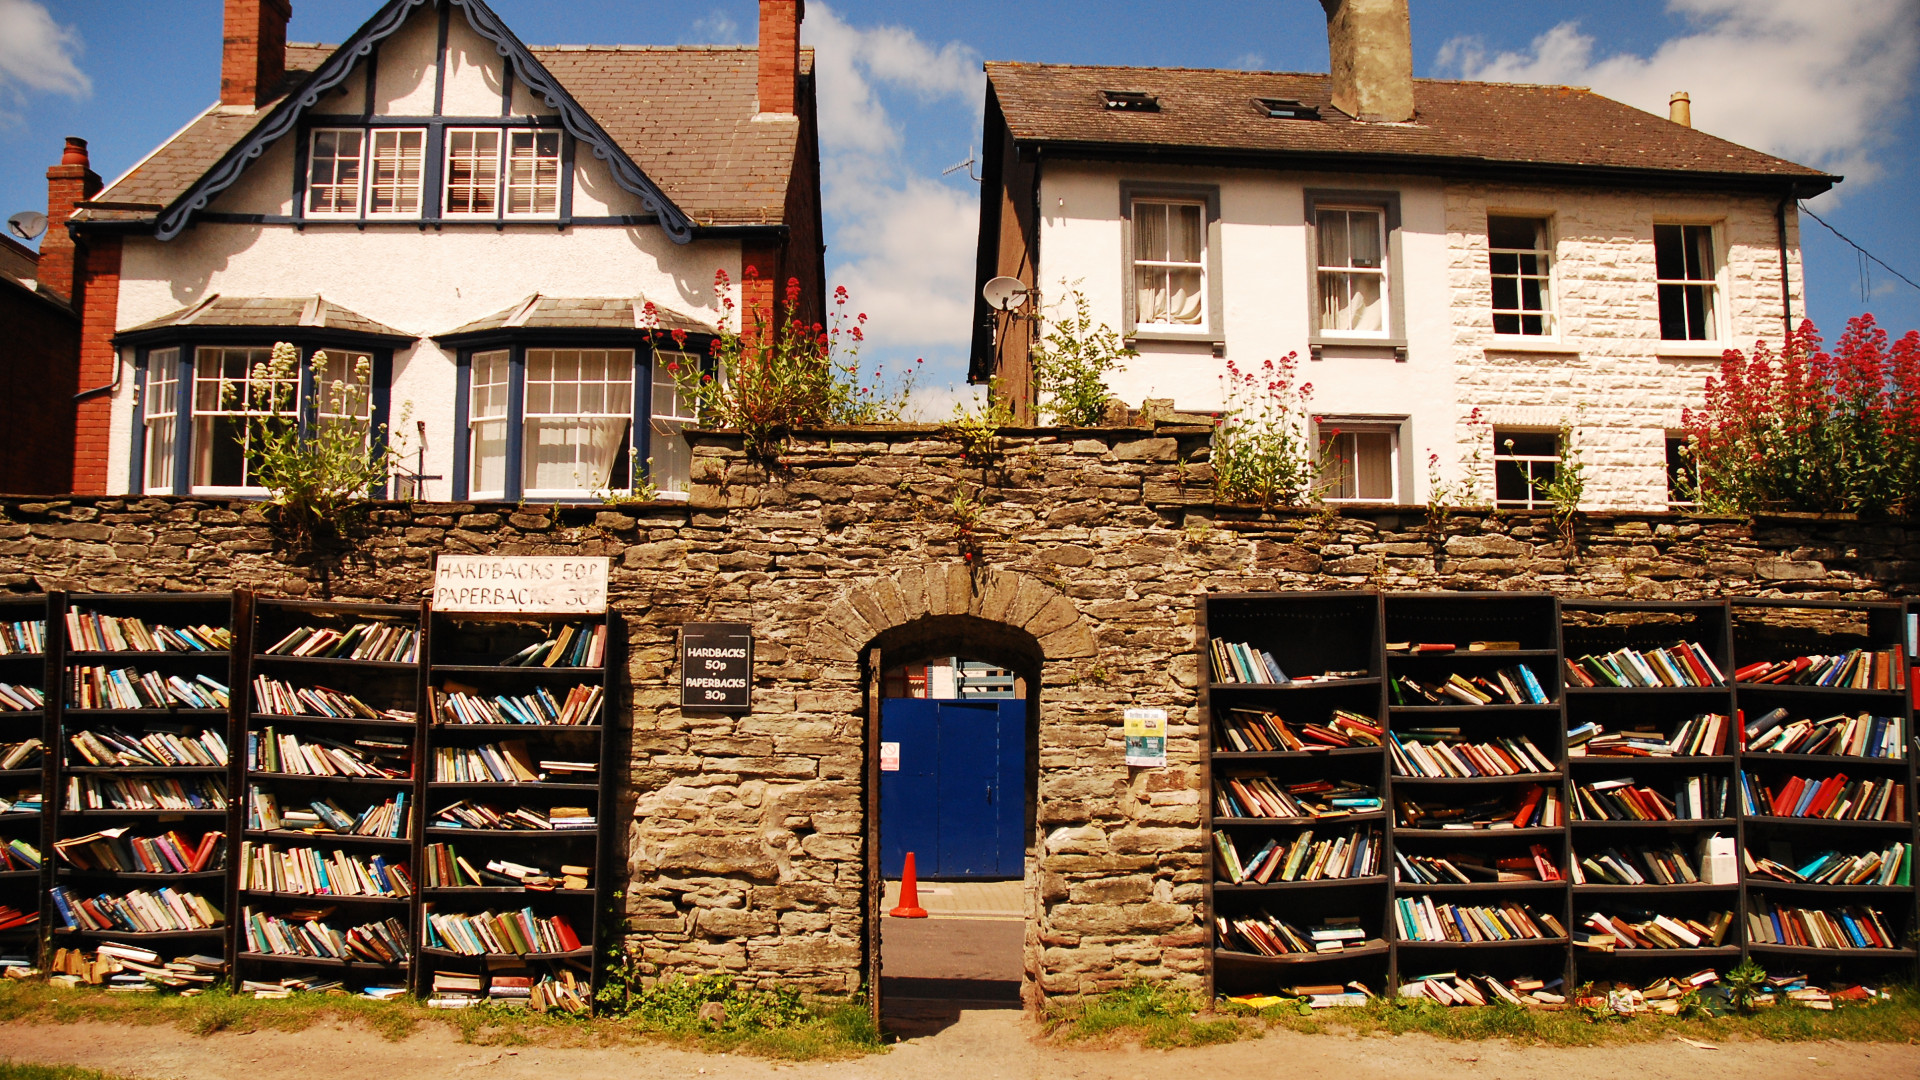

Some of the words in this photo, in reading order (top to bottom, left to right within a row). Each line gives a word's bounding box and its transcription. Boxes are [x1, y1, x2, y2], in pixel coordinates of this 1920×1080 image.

[440, 563, 554, 580] HARDBACKS
[687, 647, 746, 658] HARDBACKS
[705, 660, 727, 671] 50p
[685, 677, 746, 688] PAPERBACKS
[705, 690, 726, 701] 30p
